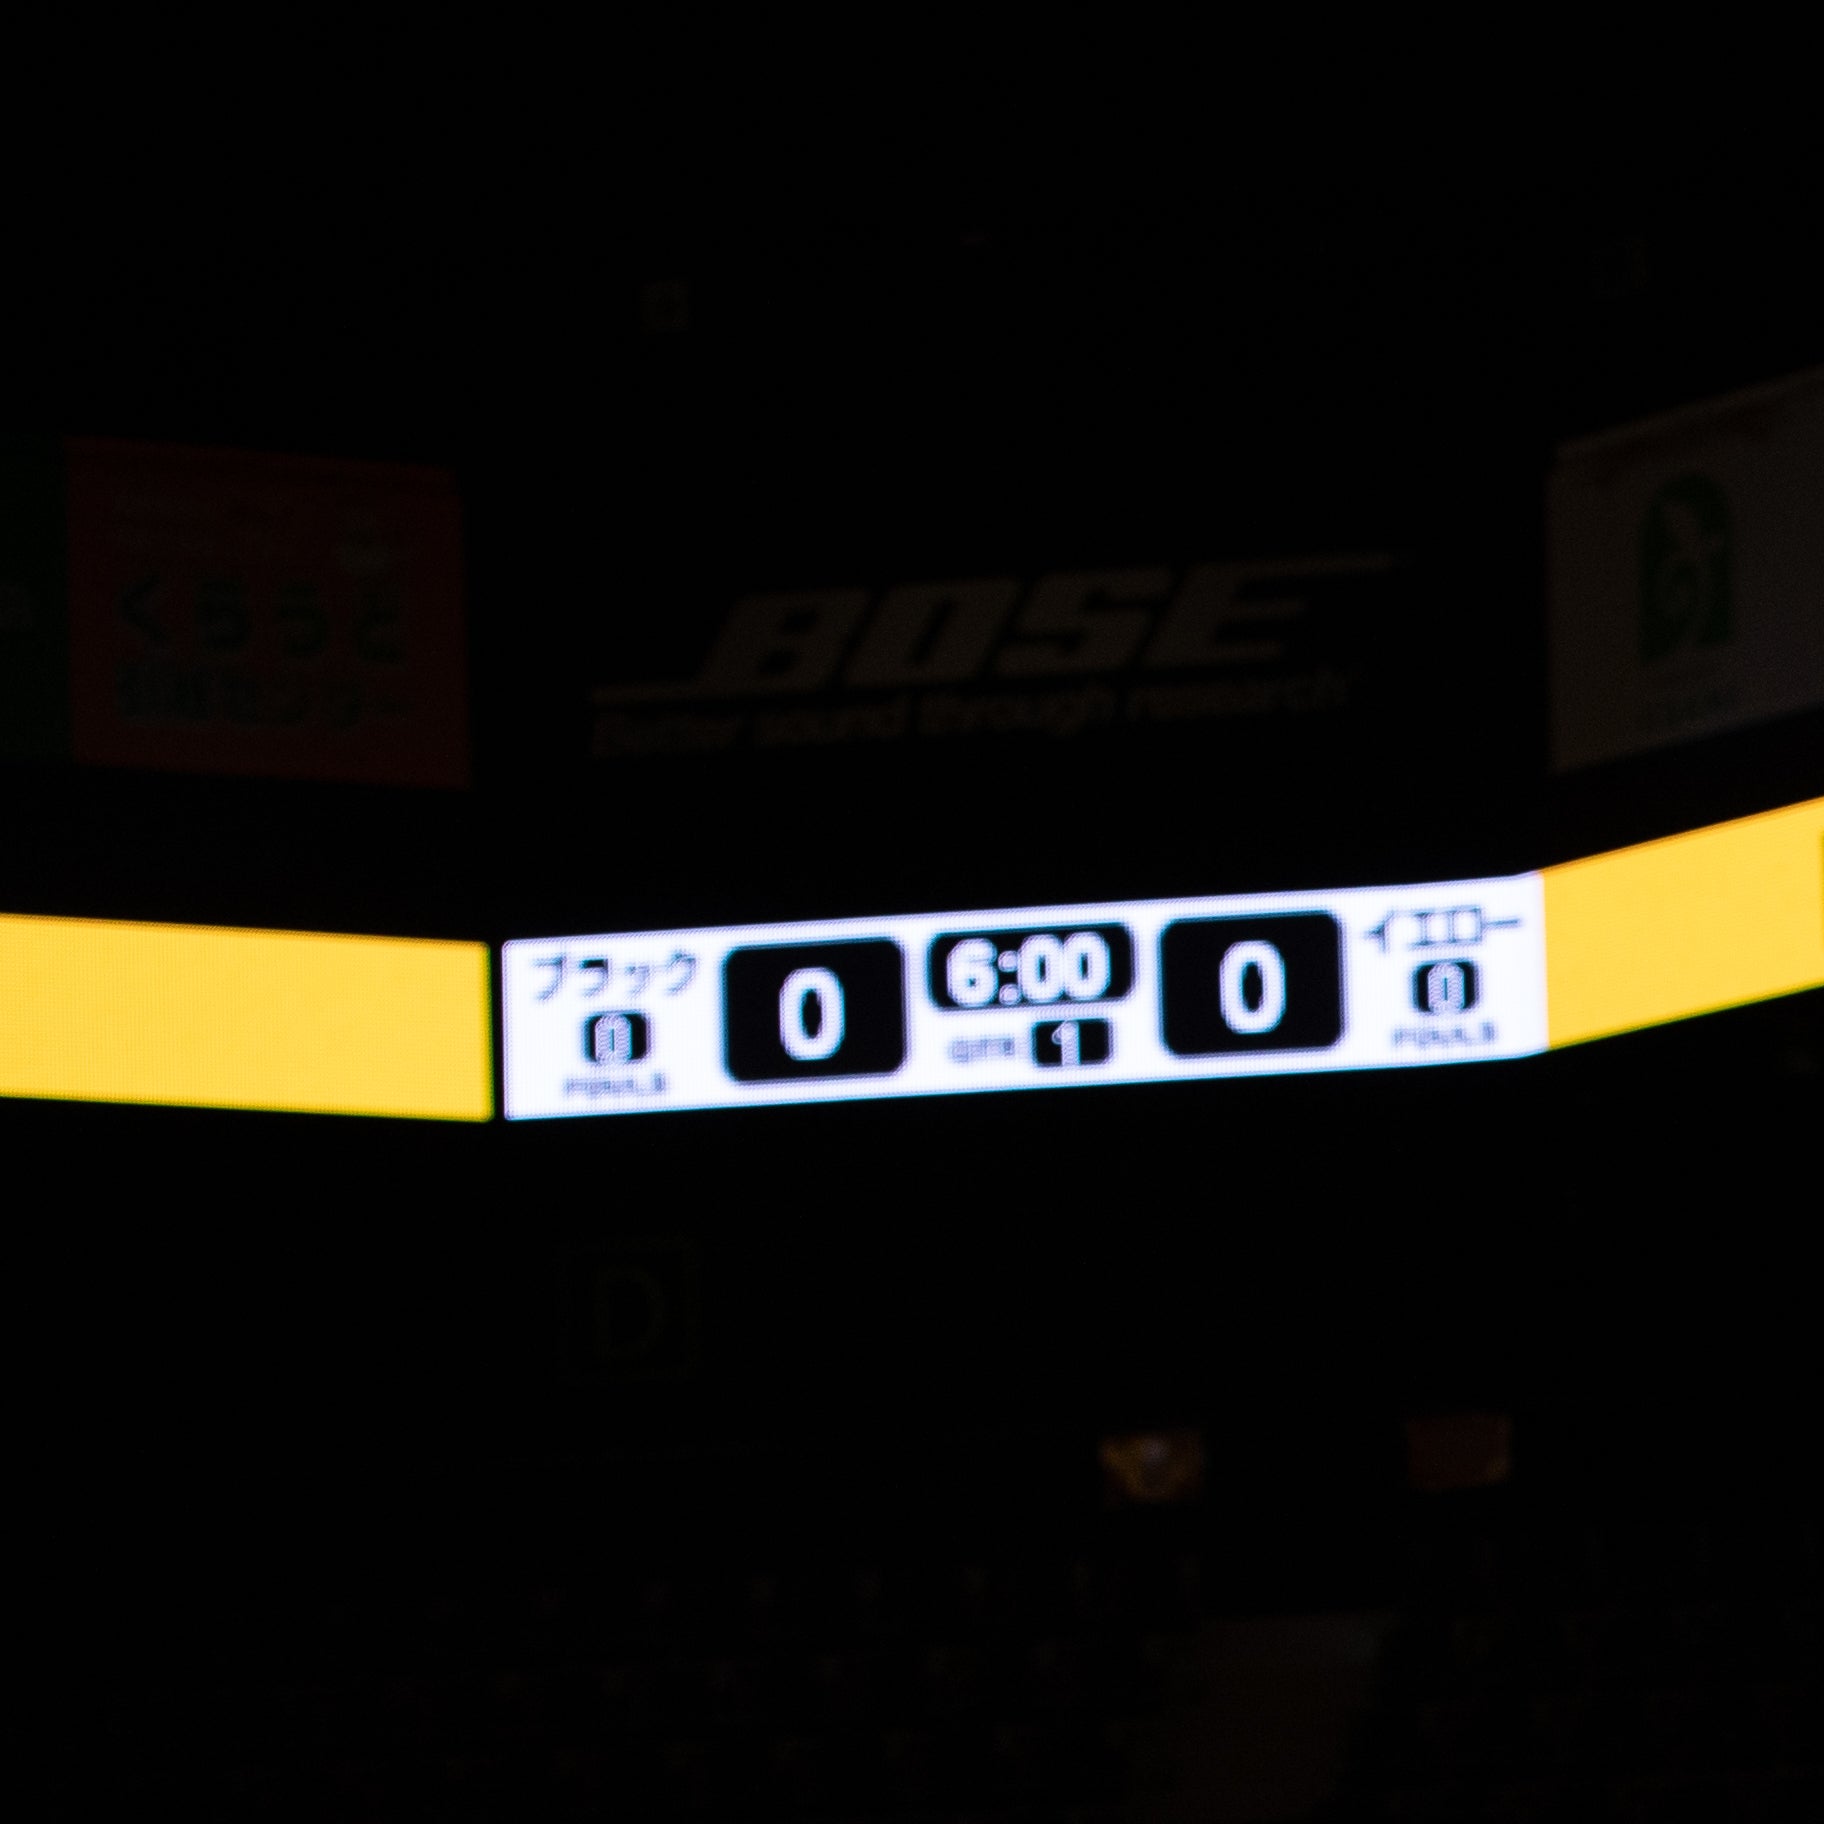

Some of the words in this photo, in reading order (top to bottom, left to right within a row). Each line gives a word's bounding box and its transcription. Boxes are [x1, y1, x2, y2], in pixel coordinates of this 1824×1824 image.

[591, 550, 1400, 705] BOSE
[779, 966, 846, 1061] 0
[945, 931, 1111, 1008] 6:00
[1219, 940, 1286, 1035] 0
[1051, 1019, 1081, 1067] 1
